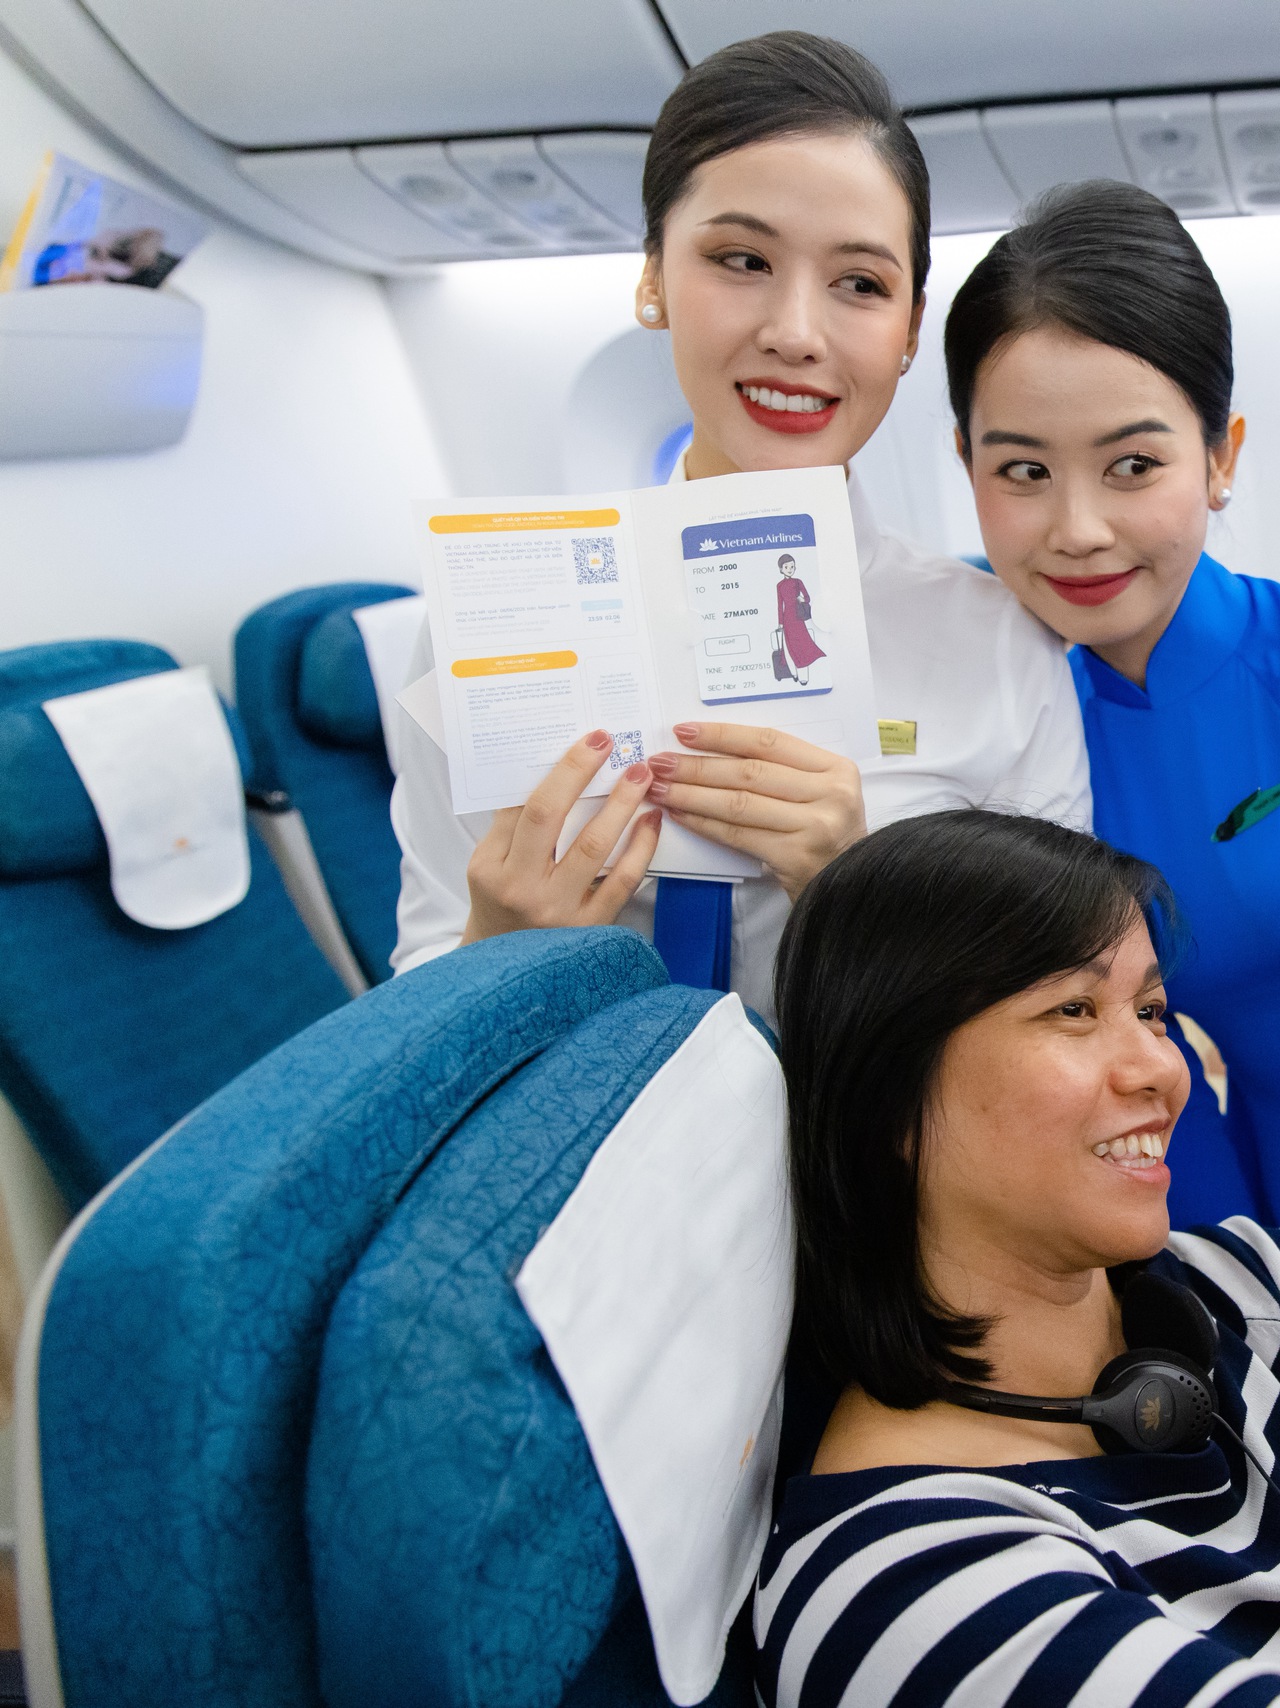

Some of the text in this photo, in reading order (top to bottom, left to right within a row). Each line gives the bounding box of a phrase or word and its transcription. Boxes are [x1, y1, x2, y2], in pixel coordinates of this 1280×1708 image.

[719, 533, 803, 549] Vietnam Airlines
[693, 563, 738, 575] FROM 2000
[695, 582, 739, 594] TO 2015
[701, 608, 759, 621] ATE 27MAY00
[705, 662, 771, 675] TKNE 2750027515
[743, 681, 756, 689] 275
